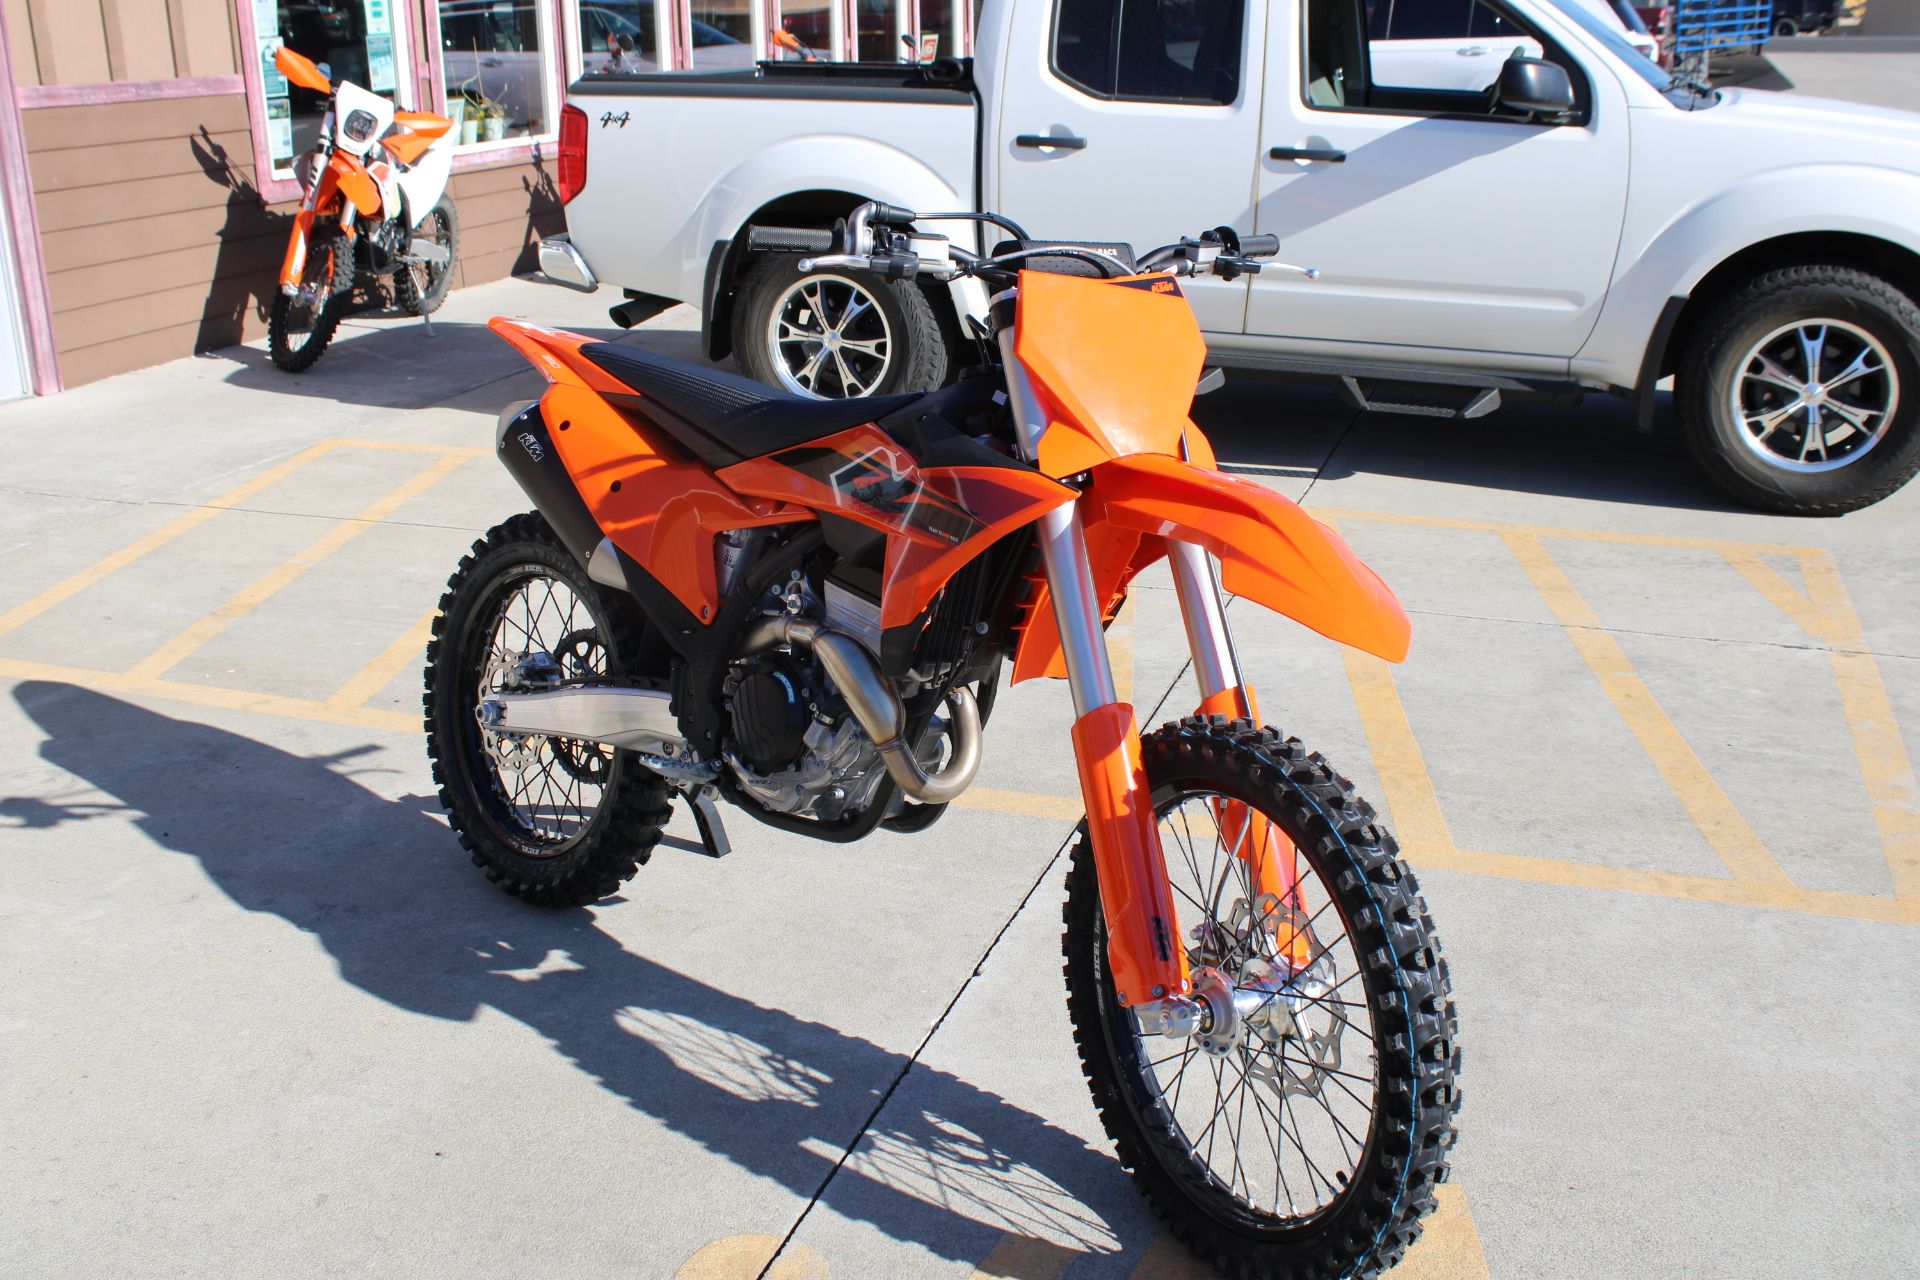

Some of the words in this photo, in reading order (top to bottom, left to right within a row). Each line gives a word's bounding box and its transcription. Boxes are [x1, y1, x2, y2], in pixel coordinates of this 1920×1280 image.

[1151, 281, 1175, 293] KTM
[518, 433, 544, 461] KTM
[1093, 940, 1101, 980] EXCEL
